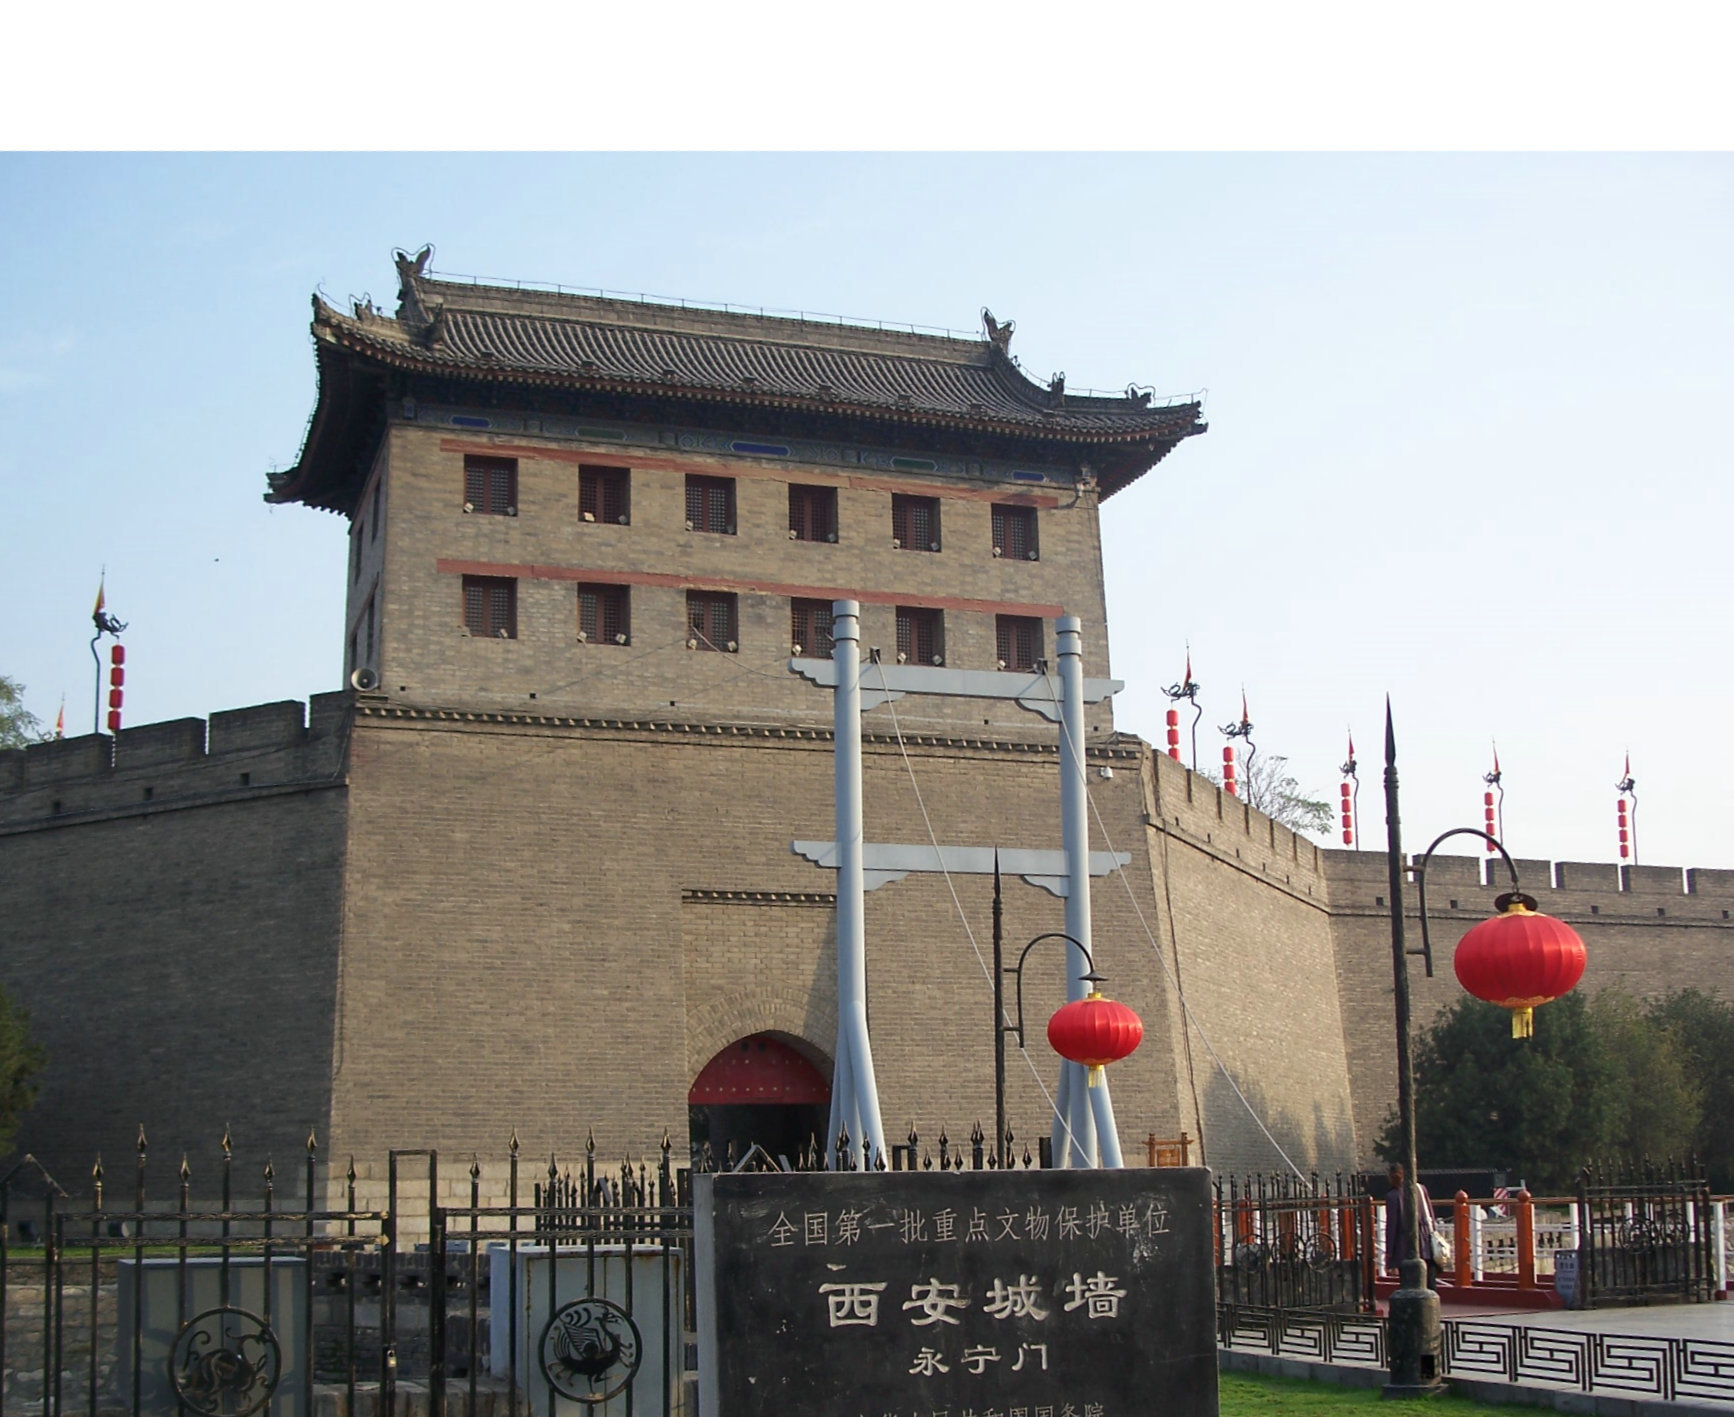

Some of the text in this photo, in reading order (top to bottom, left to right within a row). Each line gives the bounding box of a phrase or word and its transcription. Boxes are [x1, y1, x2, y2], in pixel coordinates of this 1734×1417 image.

[768, 1202, 1171, 1247] 全国第一批重点文物保护单位
[818, 1271, 1127, 1328] 西安城墙
[908, 1343, 1049, 1376] 永宁门
